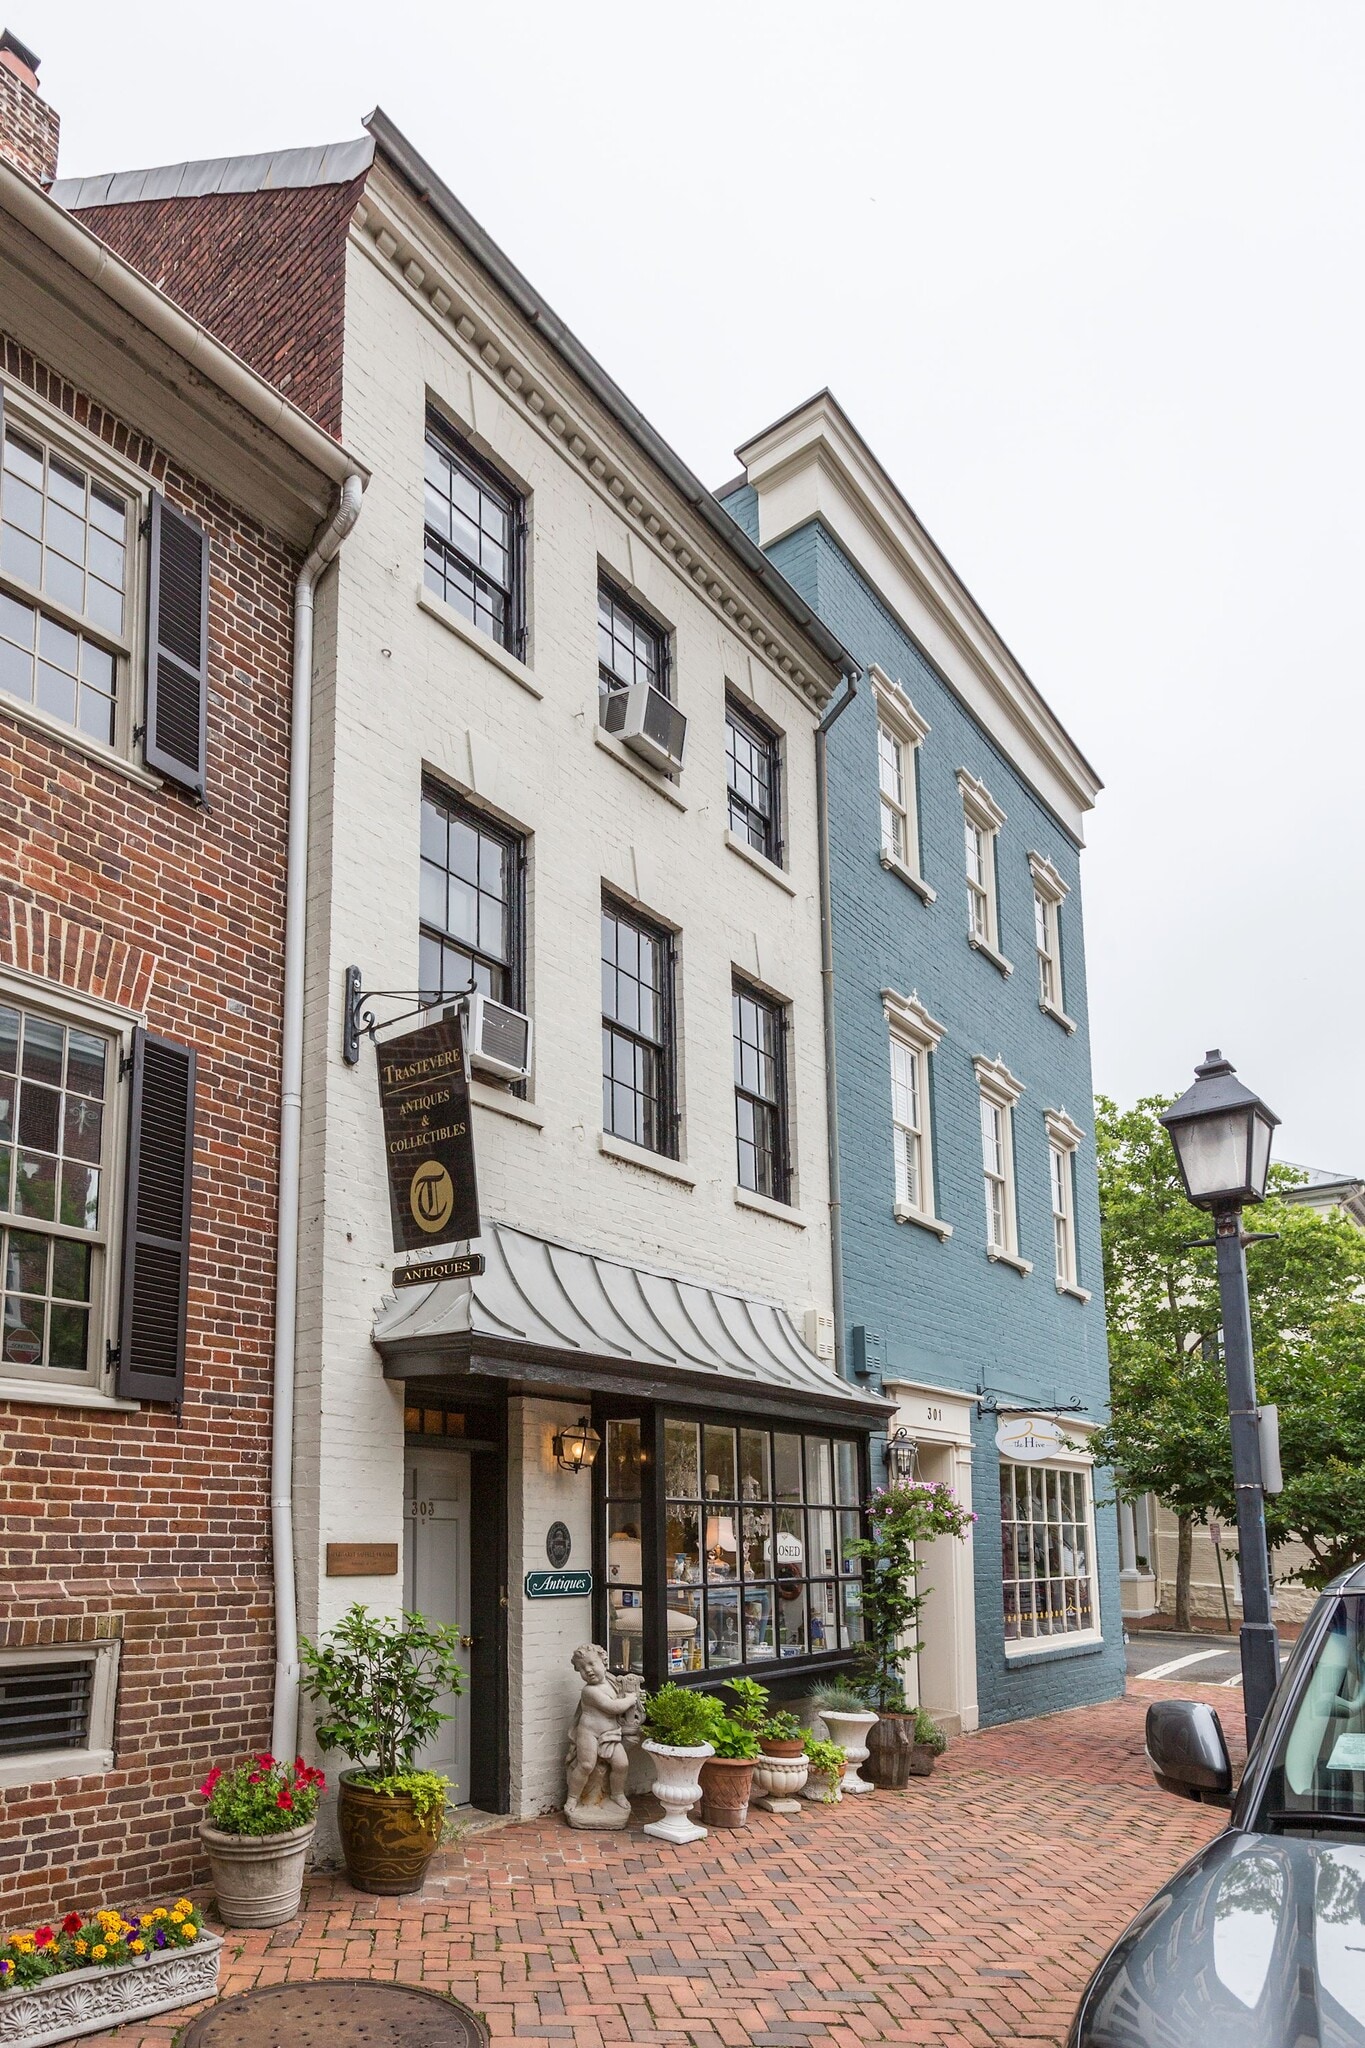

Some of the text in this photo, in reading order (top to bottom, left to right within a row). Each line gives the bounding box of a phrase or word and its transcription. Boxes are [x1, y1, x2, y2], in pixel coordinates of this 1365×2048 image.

[383, 1048, 460, 1084] TRASTEVERE
[400, 1089, 450, 1116] ANTIQUES
[421, 1114, 430, 1127] &
[390, 1122, 466, 1154] COLLECTIBLES
[403, 1260, 471, 1281] ANTIQUES
[927, 1407, 942, 1421] 301
[411, 1501, 435, 1516] 303
[768, 1545, 800, 1556] COSED
[532, 1575, 586, 1592] Antiques
